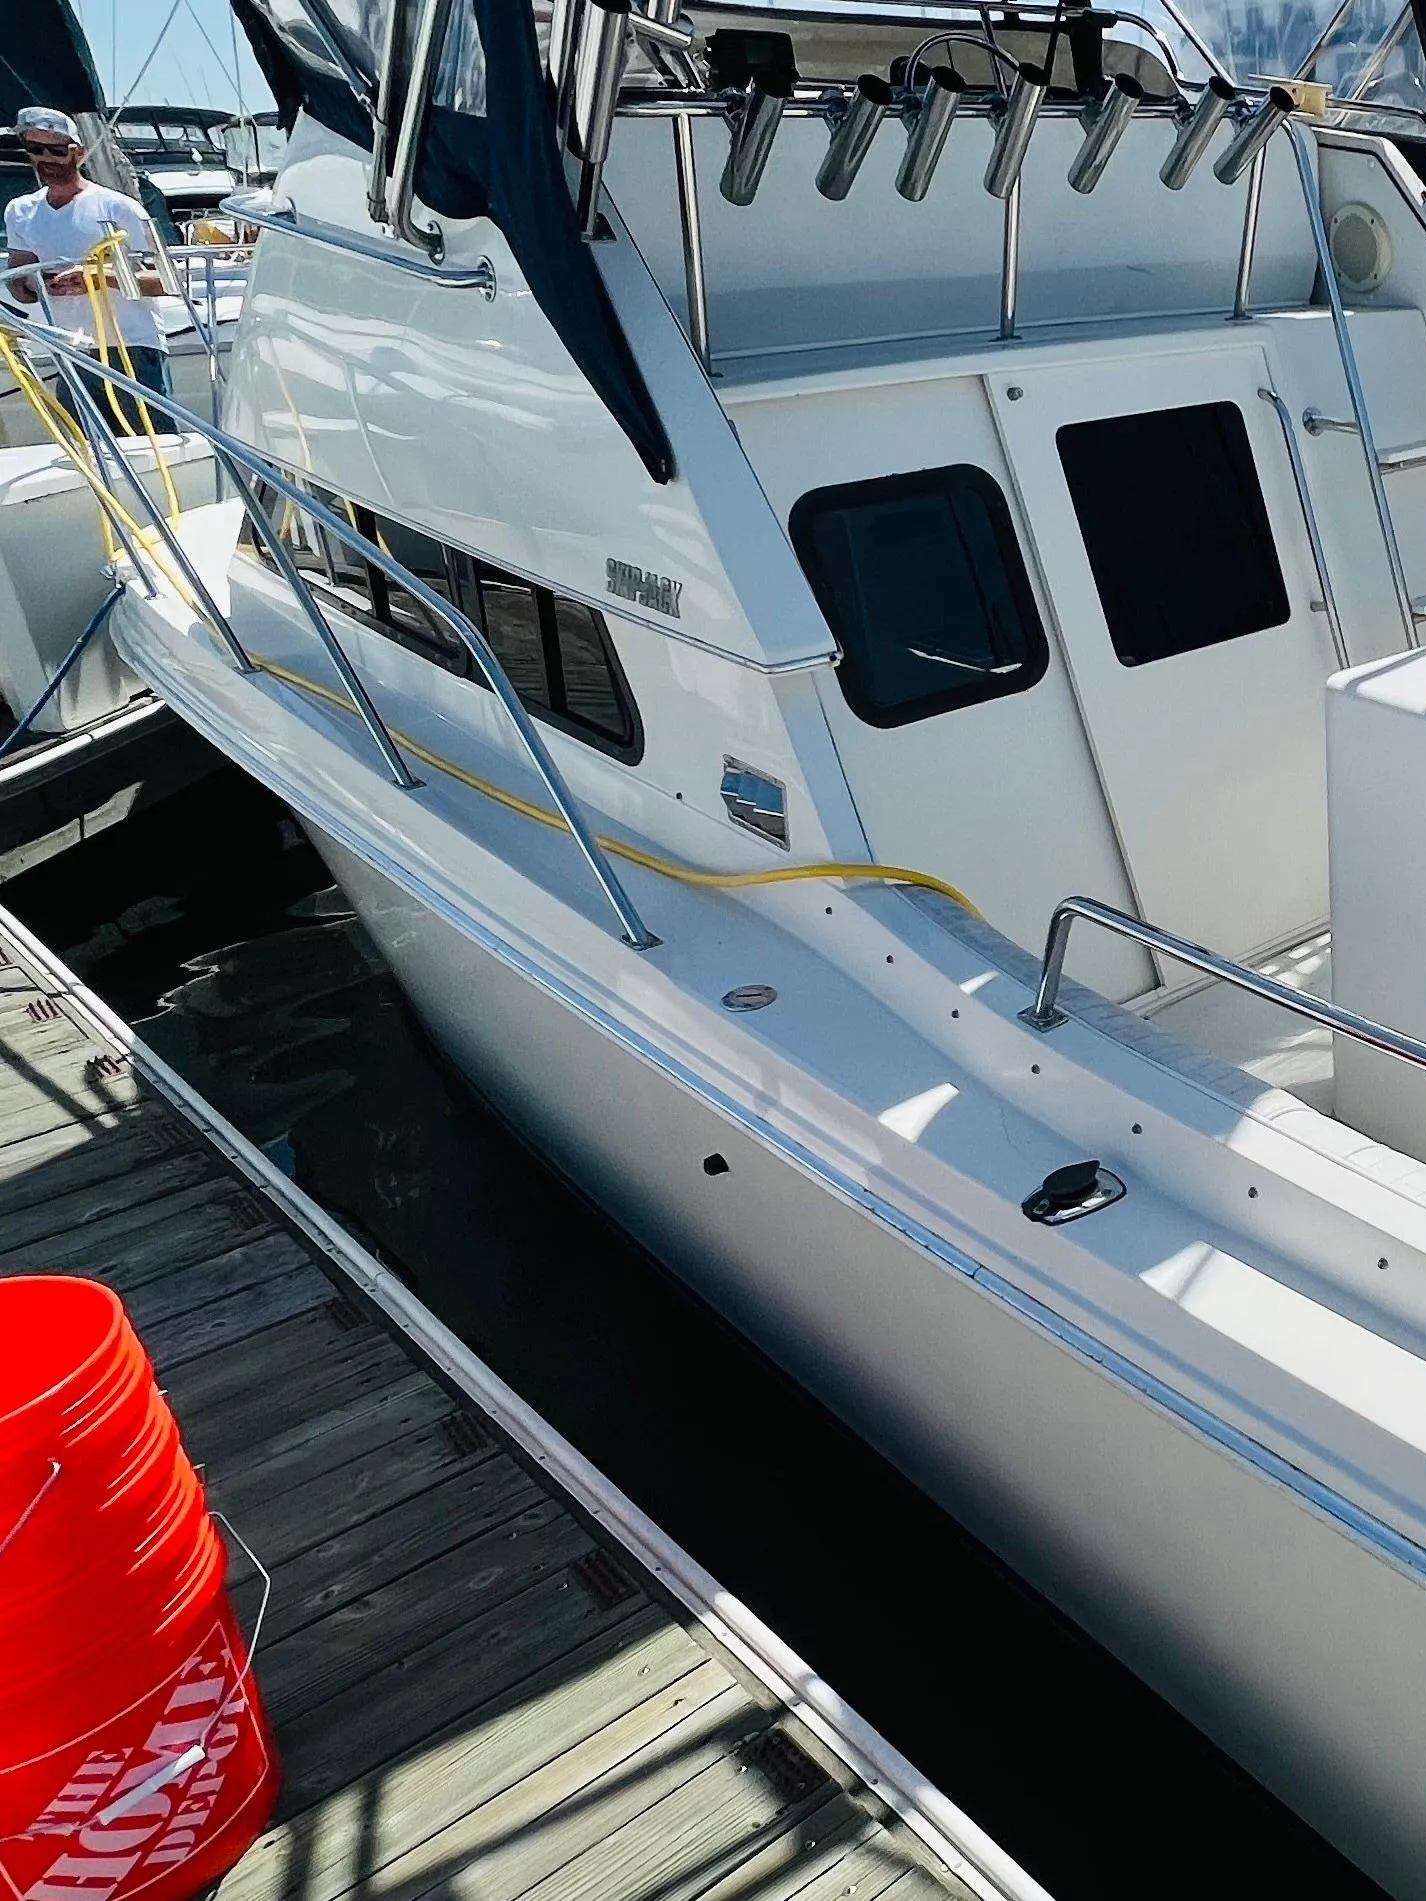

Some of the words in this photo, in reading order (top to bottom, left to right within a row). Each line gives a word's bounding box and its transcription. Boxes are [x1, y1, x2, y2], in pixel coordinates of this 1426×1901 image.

[18, 1746, 134, 1841] THE
[20, 1648, 233, 1901] HOME
[143, 1697, 249, 1867] DEPOT
